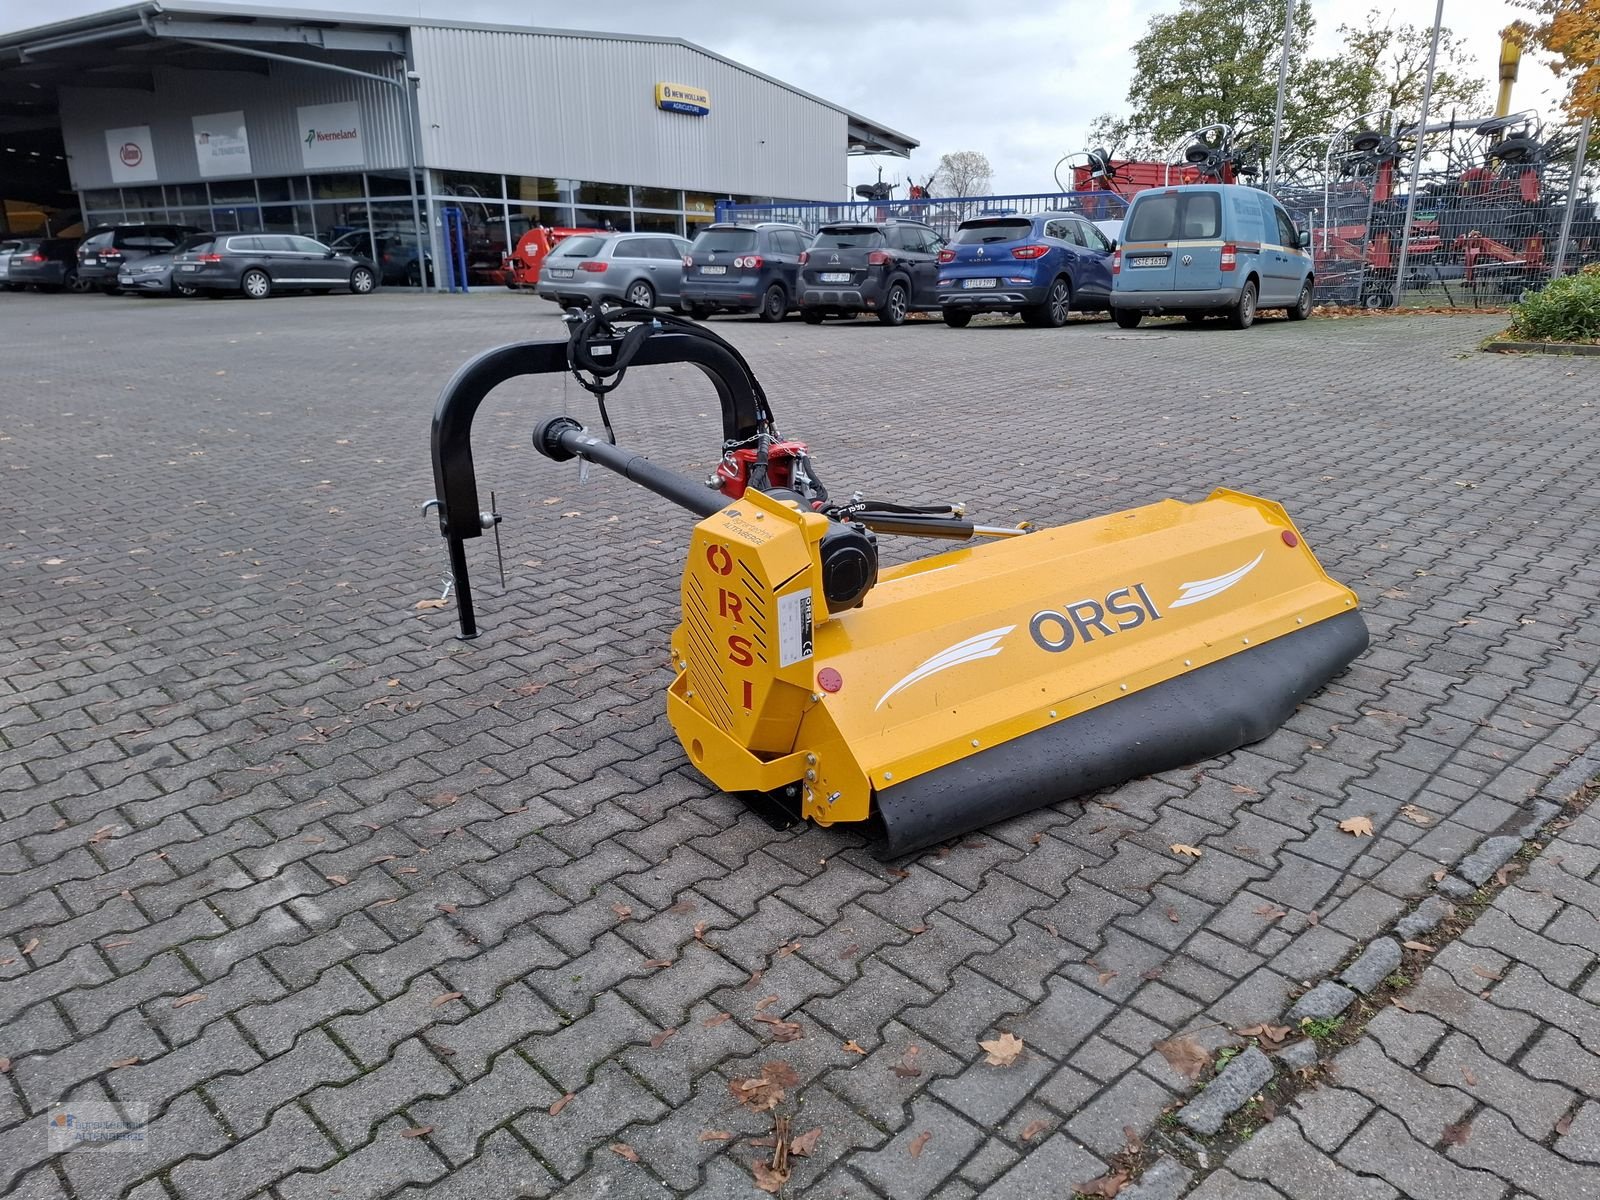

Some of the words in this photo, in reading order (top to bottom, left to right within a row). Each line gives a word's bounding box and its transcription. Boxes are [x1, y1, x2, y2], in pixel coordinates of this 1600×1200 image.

[672, 90, 683, 99] NEW
[685, 93, 706, 103] HOLLAND
[673, 103, 699, 113] AGRICULTURE
[316, 128, 357, 142] Kverneland
[1150, 257, 1167, 265] 1610
[723, 522, 765, 546] ALTENBERGE
[1028, 582, 1164, 653] ORSI
